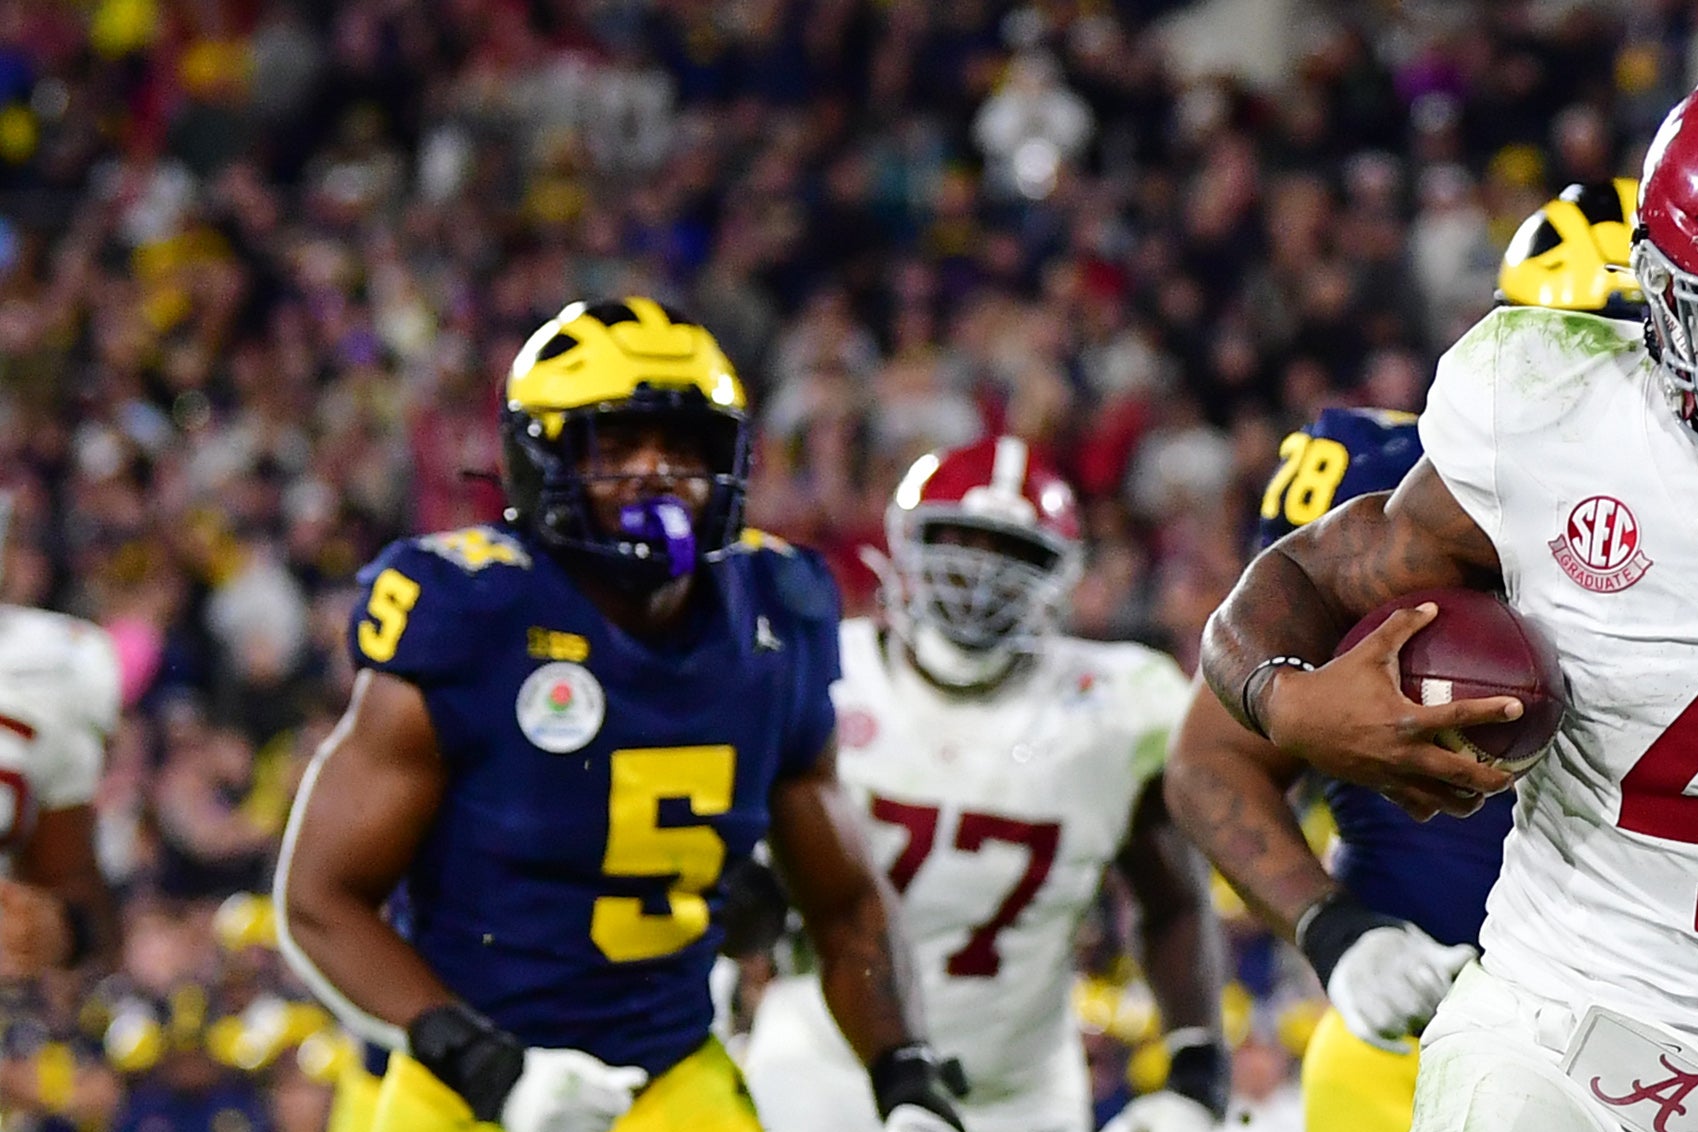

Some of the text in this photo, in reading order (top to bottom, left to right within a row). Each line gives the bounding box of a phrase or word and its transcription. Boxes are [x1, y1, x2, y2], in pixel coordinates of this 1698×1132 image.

[1560, 554, 1634, 591] GRADUATE
[1571, 498, 1635, 568] SEC
[357, 568, 421, 662] 5
[591, 744, 736, 963] 5
[871, 796, 1061, 977] 77
